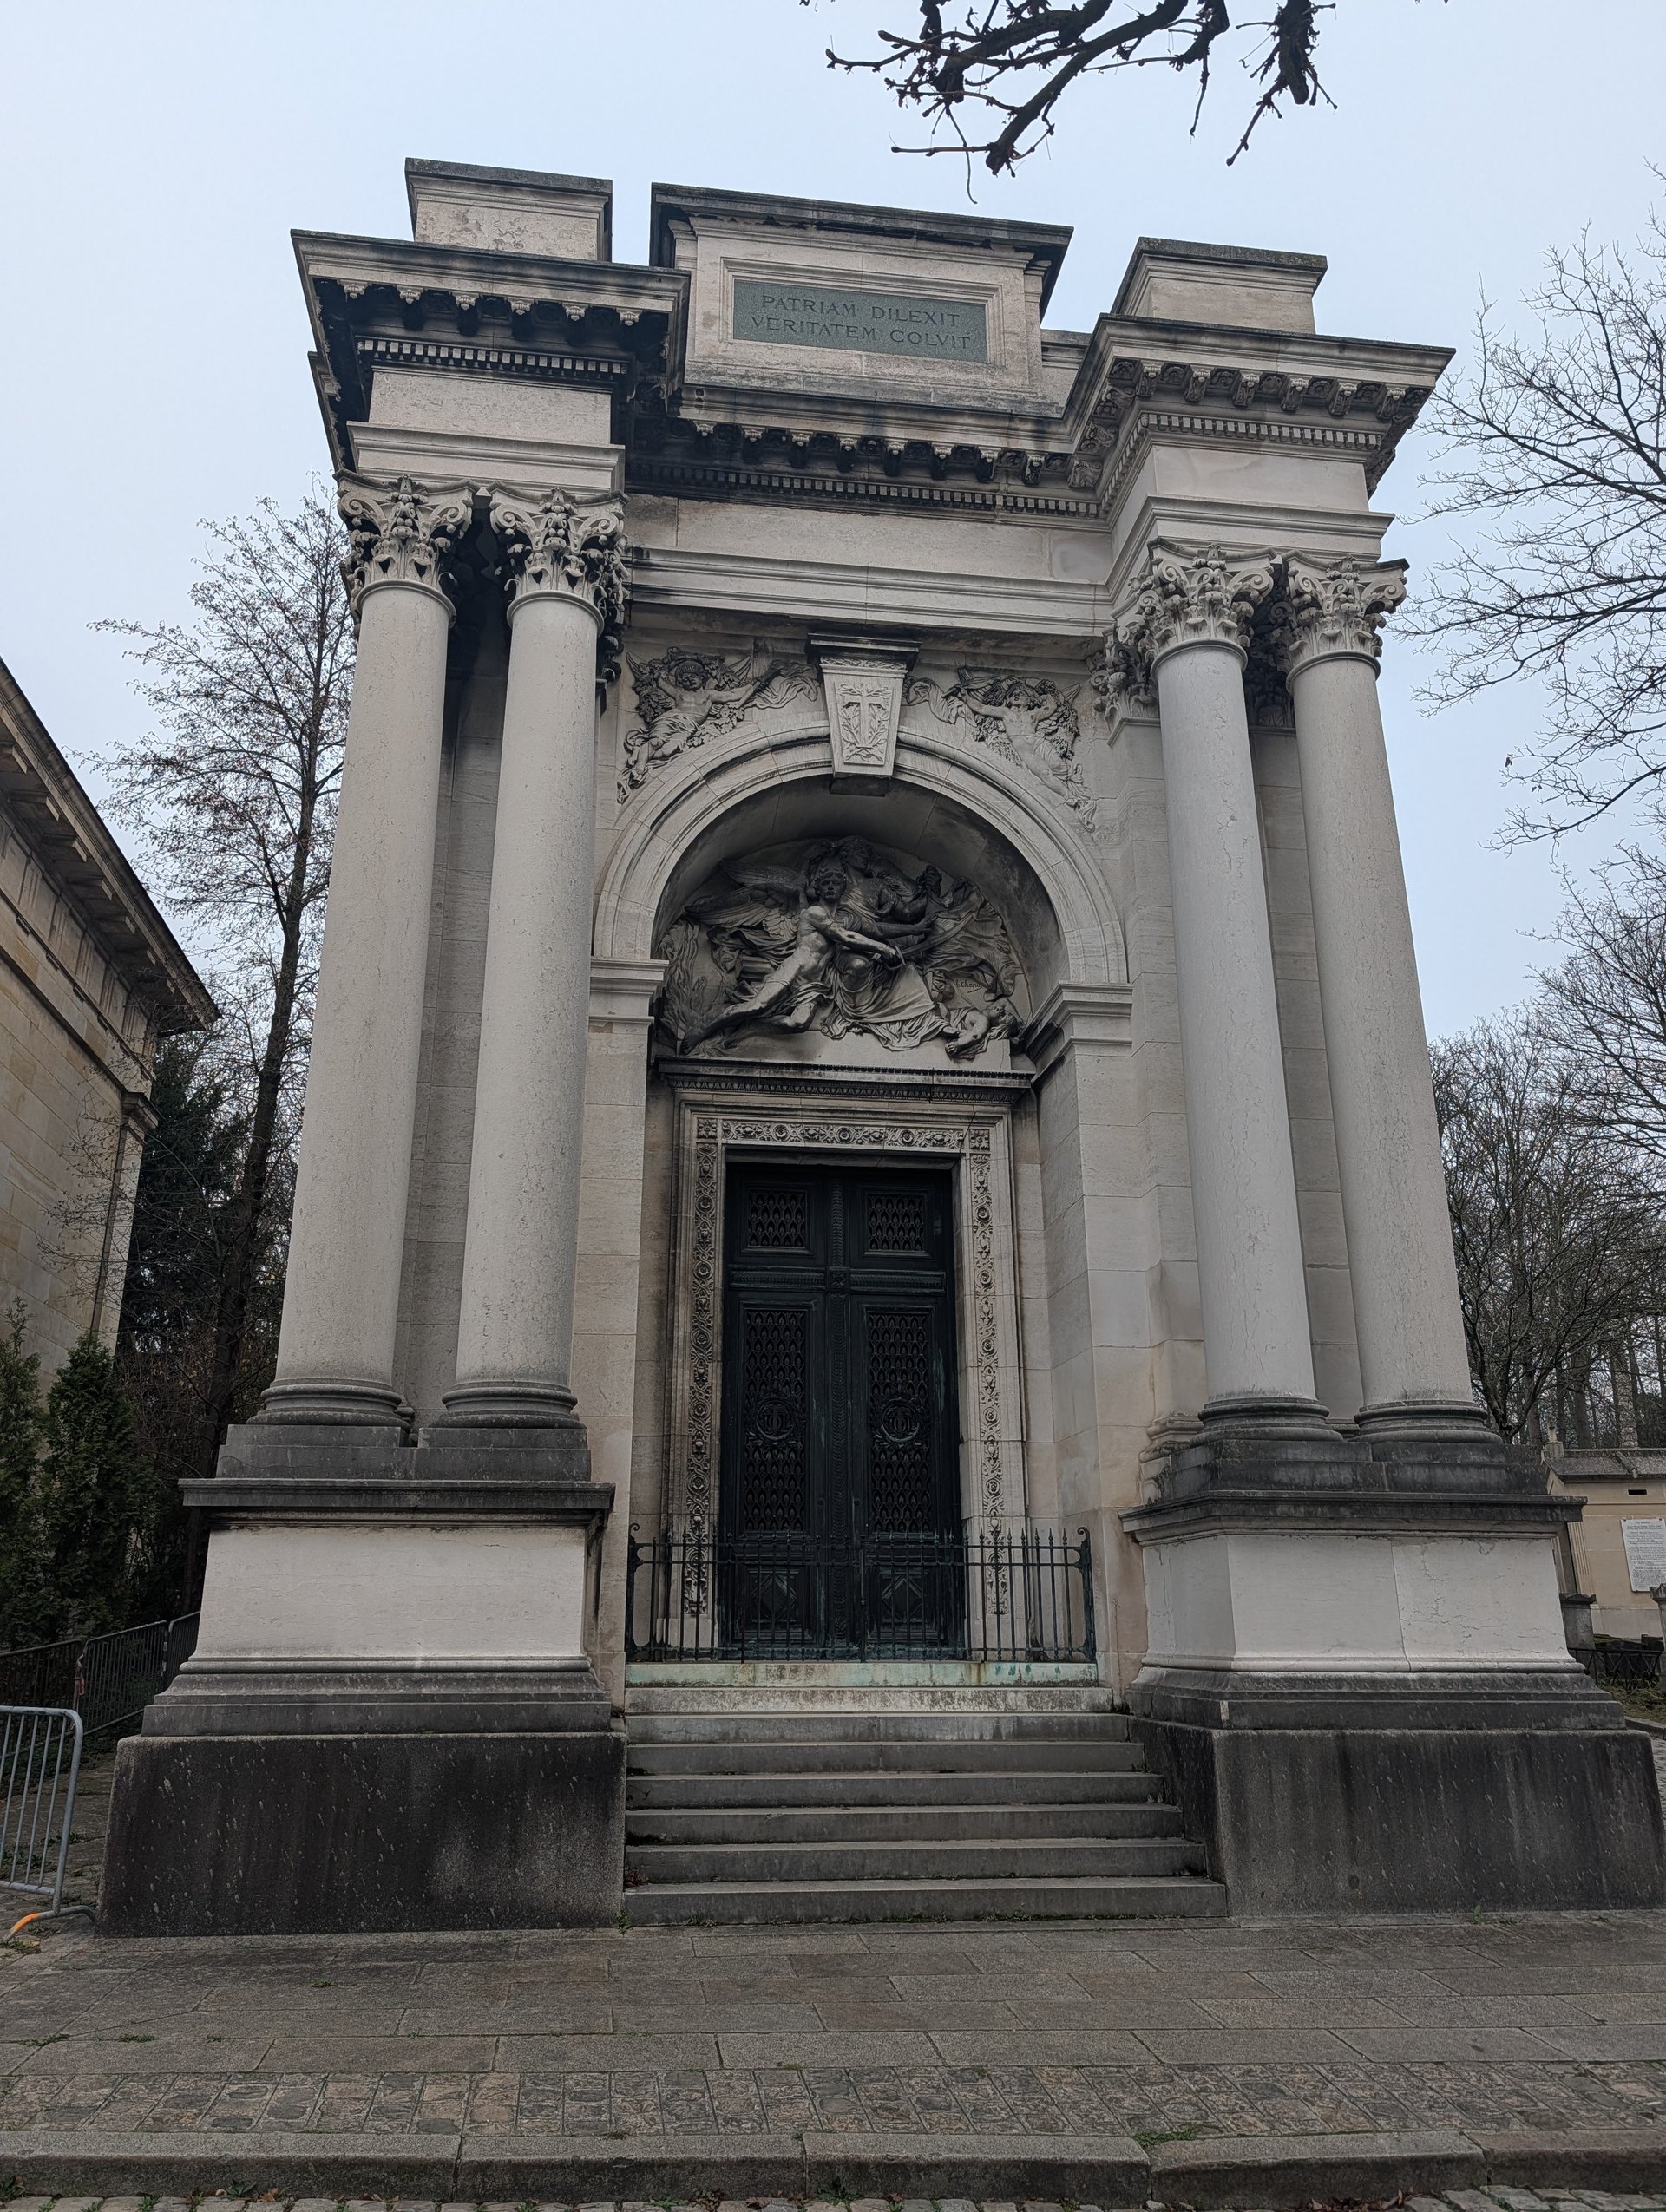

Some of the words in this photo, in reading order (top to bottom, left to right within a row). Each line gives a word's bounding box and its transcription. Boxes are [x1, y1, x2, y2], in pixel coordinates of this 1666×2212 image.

[762, 295, 856, 317] PATRIAM
[872, 306, 960, 327] DILEXIT
[751, 316, 876, 341] VERITATEM
[890, 329, 970, 349] COLVIT
